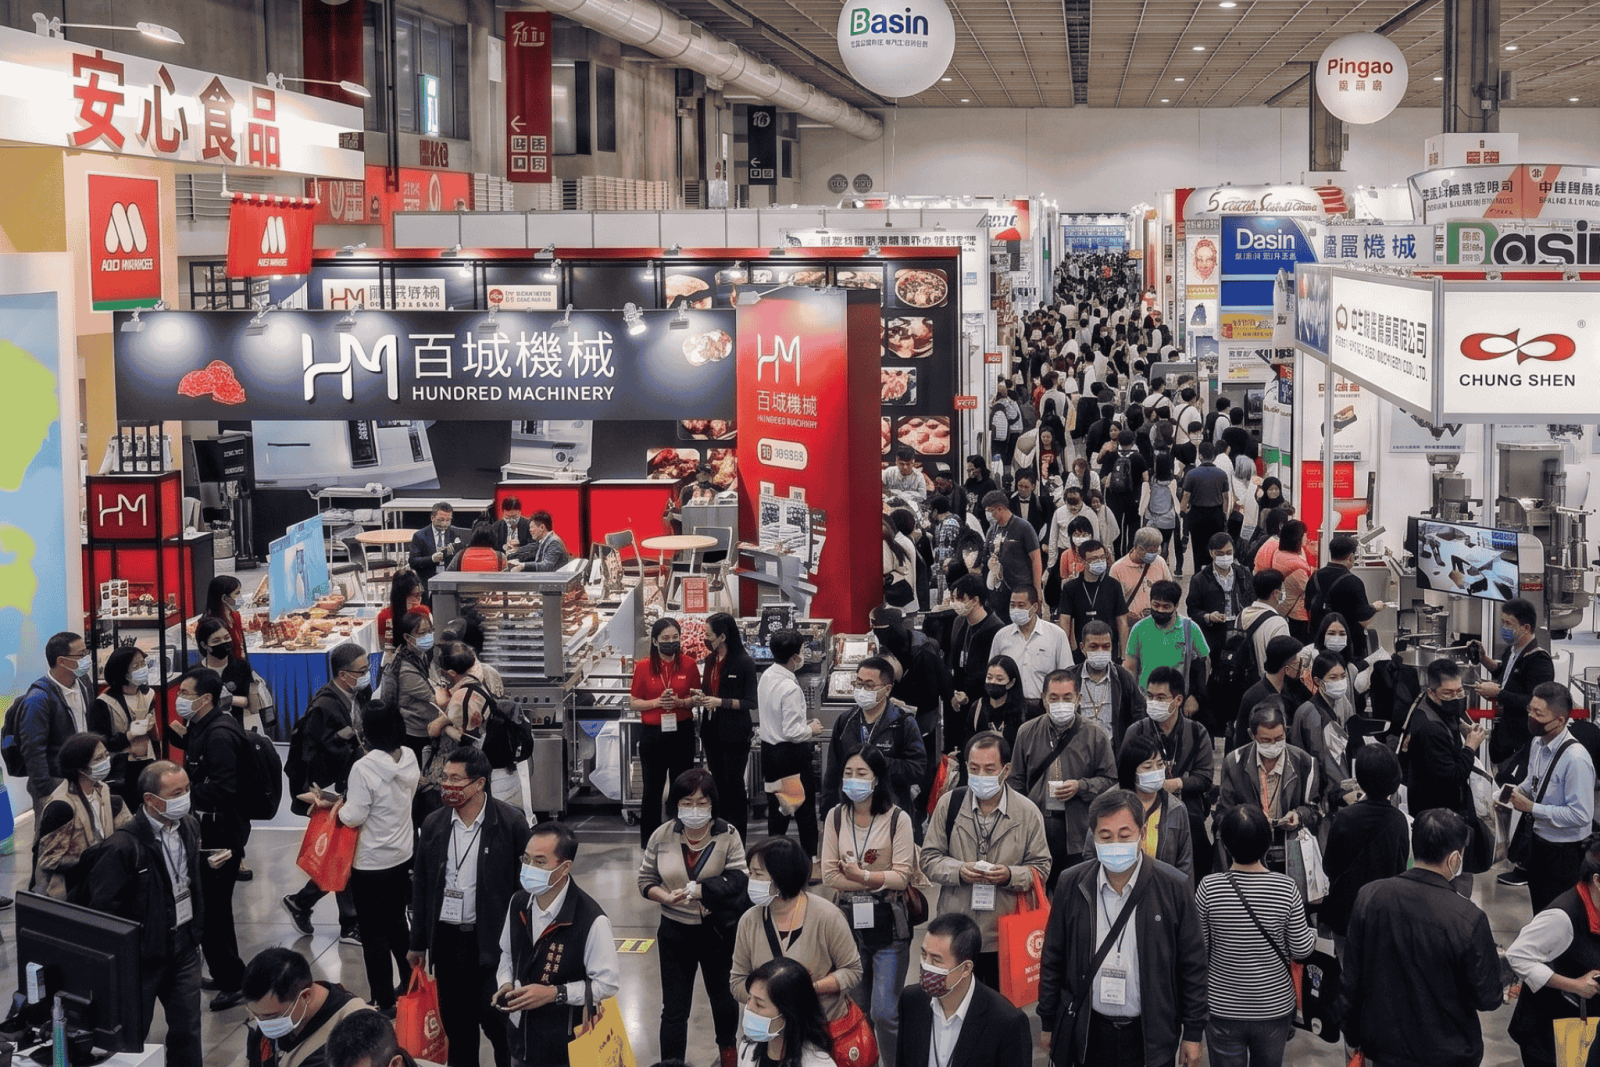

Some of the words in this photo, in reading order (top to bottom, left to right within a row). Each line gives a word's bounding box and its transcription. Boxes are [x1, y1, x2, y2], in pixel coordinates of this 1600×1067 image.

[850, 7, 929, 36] Basin
[1327, 57, 1394, 78] Pingao
[68, 49, 281, 169] 安心食品
[1236, 228, 1296, 250] Dasin
[1446, 219, 1600, 265] Dasi
[408, 331, 615, 379] 百城機械
[1459, 374, 1522, 387] CHUNG
[1528, 374, 1576, 387] SHEN
[411, 386, 502, 401] HUNDRED
[508, 386, 615, 401] MACHINERY
